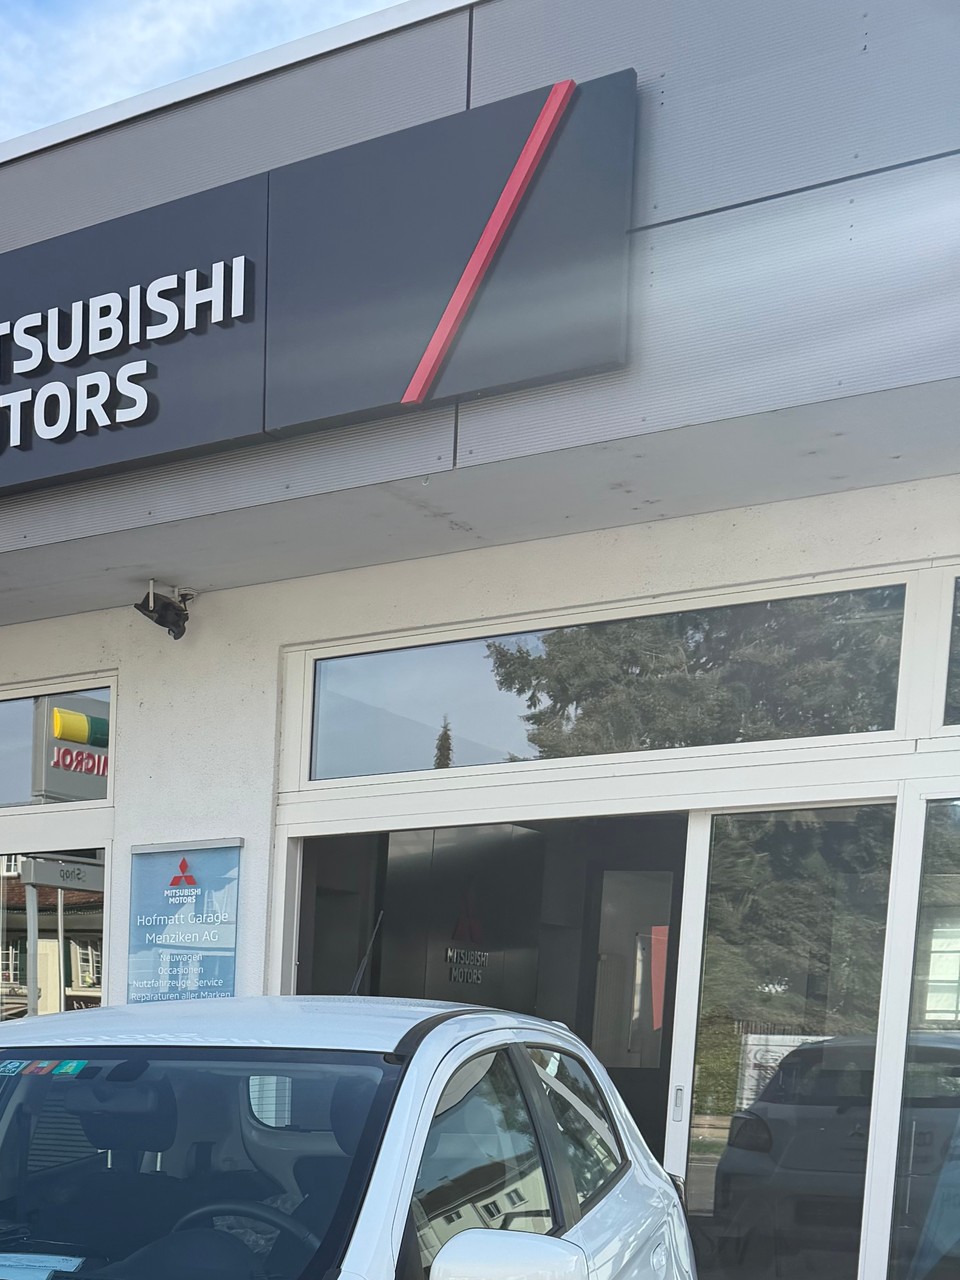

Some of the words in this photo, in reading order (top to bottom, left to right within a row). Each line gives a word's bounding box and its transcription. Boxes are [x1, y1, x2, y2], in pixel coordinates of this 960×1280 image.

[164, 888, 202, 897] MITSUBISHI
[168, 895, 196, 904] MOTORS
[137, 914, 185, 926] Hofmatt
[188, 912, 228, 926] Garage
[146, 931, 199, 944] Menziken
[202, 930, 219, 941] AG
[160, 953, 203, 963] Neuwagen
[446, 948, 489, 967] MITSUBISHI
[158, 966, 204, 975] Occasionen
[451, 967, 482, 984] MOTORS
[133, 979, 191, 988] Nutzfahrzeuge
[194, 977, 224, 987] Service
[131, 992, 180, 1002] Reparaturen
[181, 991, 198, 1000] aller
[200, 991, 231, 999] Marken
